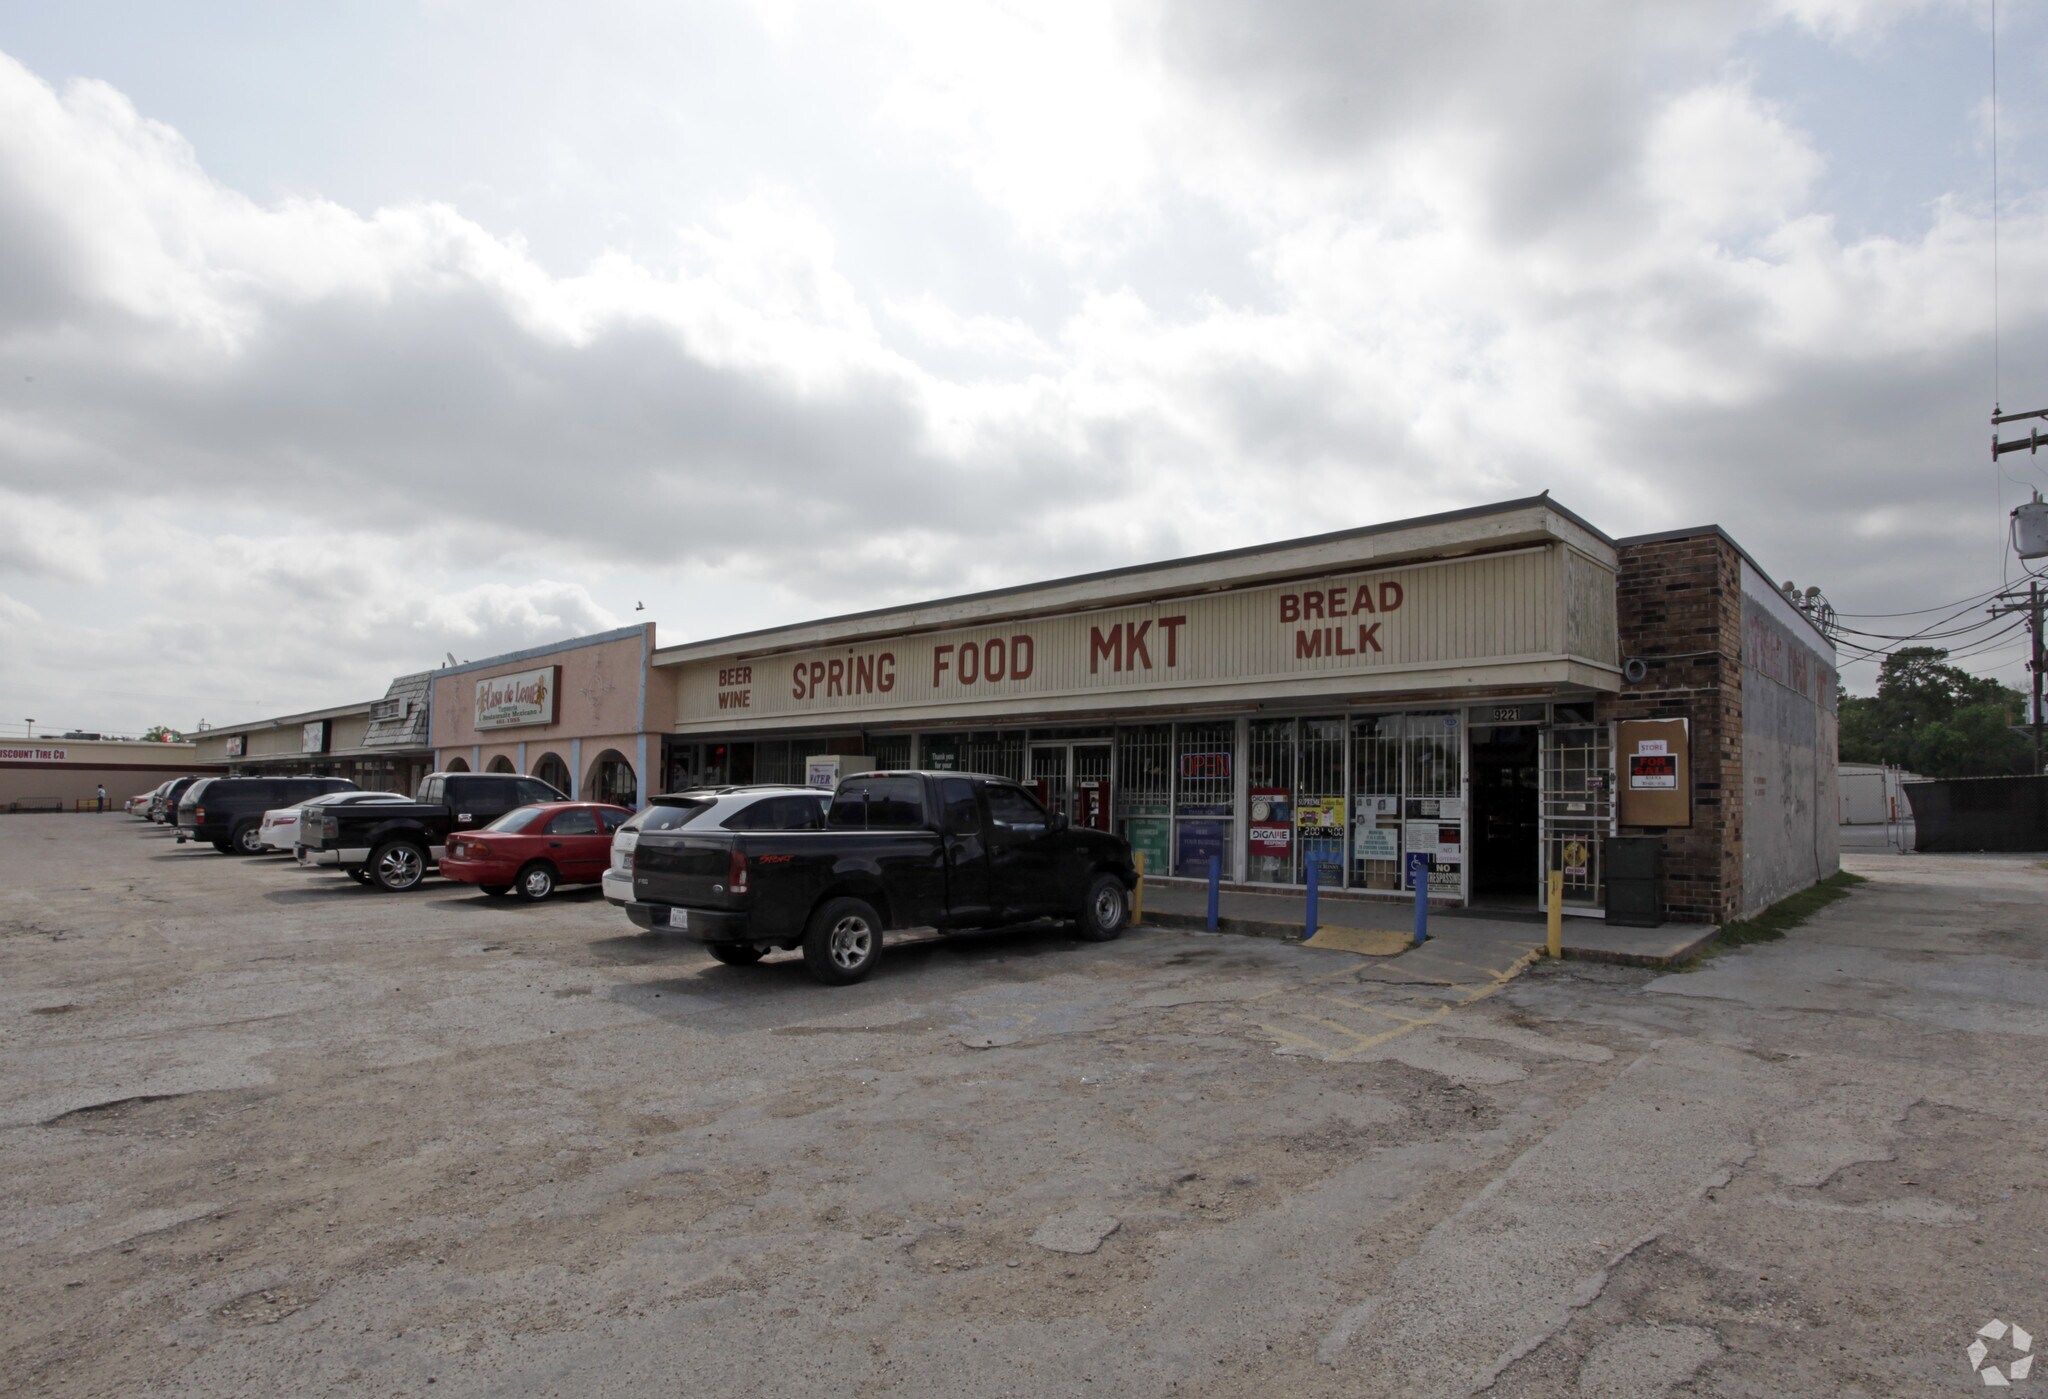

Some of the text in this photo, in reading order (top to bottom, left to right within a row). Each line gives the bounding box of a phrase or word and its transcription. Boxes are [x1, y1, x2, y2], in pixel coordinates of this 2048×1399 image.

[1280, 581, 1404, 624] BREAD
[1296, 622, 1383, 660] MILK
[933, 634, 1034, 688] FOOD
[1090, 615, 1187, 674] MKT
[719, 666, 752, 687] BEER
[504, 683, 514, 703] de
[718, 690, 751, 710] WINE
[1494, 709, 1520, 720] 9221
[0, 749, 33, 759] ISCOUNT
[932, 752, 954, 762] Thank you
[1640, 757, 1666, 766] FOR
[1183, 755, 1229, 777] OPEN
[1634, 766, 1673, 775] SALE
[1436, 863, 1451, 872] NO
